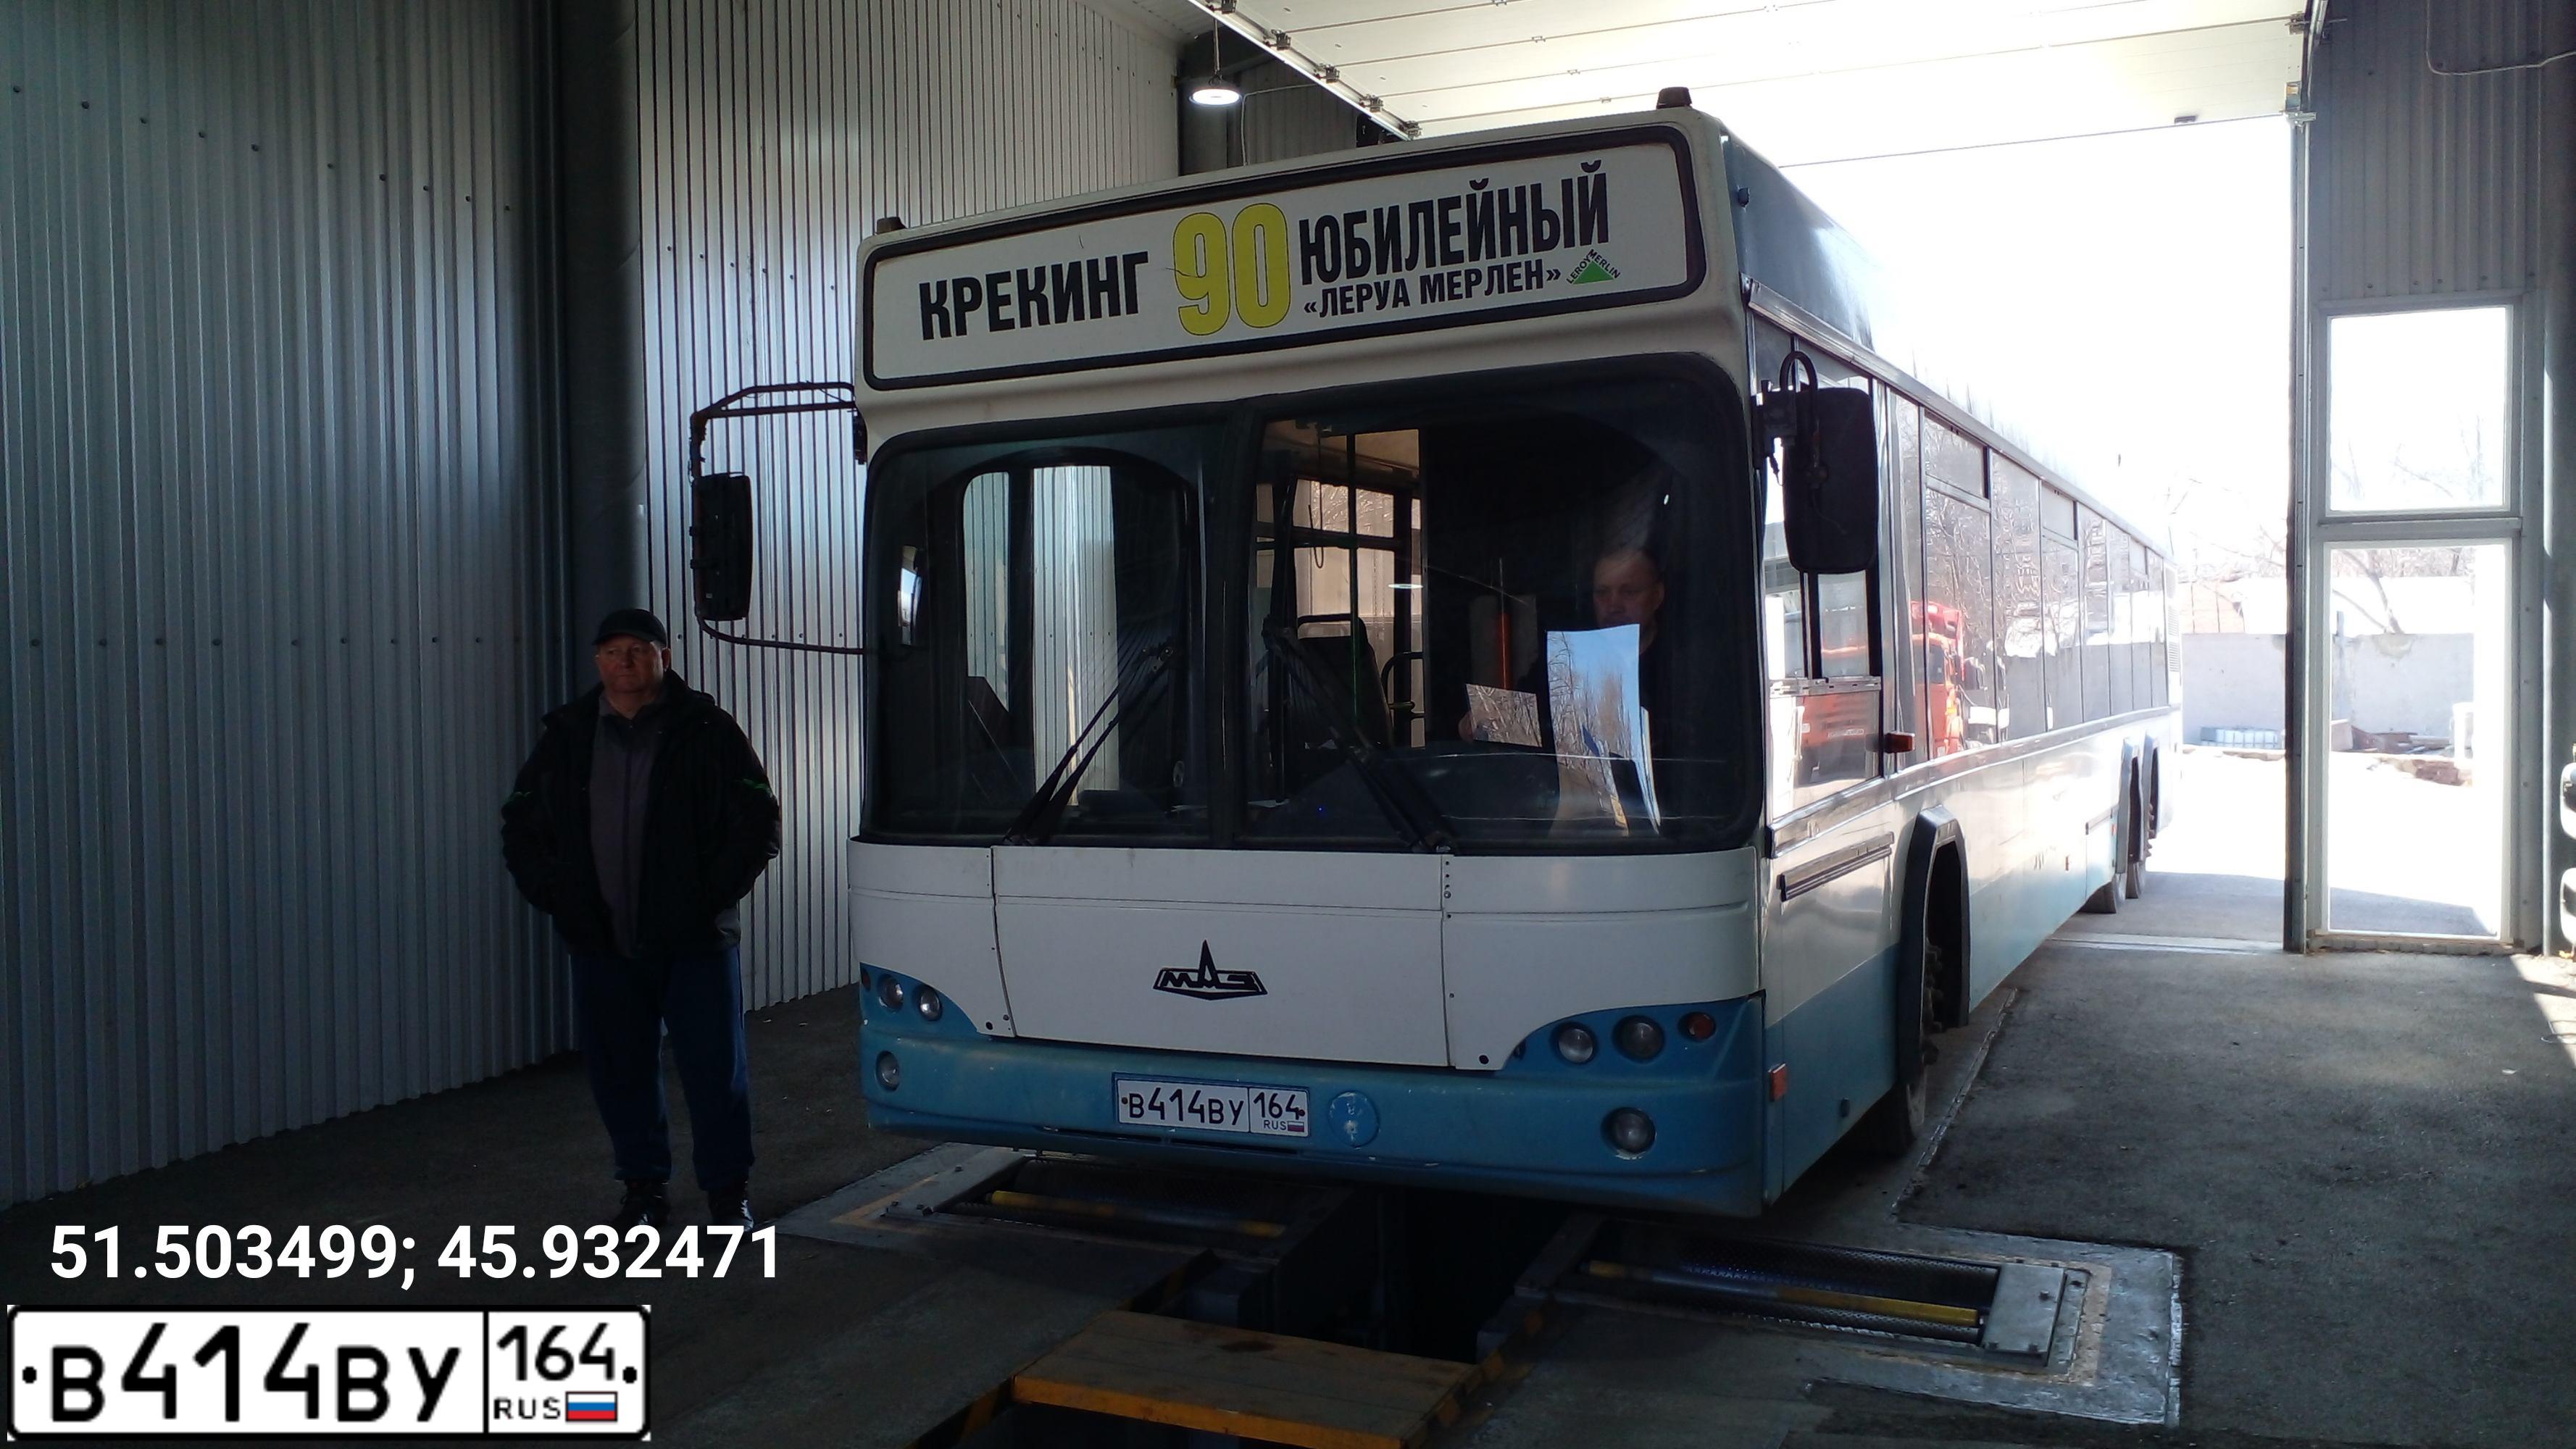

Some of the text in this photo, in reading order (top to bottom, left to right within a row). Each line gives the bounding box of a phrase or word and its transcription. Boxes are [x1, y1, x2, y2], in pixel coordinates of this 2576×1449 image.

[918, 162, 1609, 341] КРЕКИНГ 90 ЮБИЛЕЙНЫЙ
[1566, 249, 1621, 284] LEROY MERLIN
[1304, 258, 1562, 318] «ЛЕРУА МЕРЛЕН»
[1129, 1087, 1301, 1126] В414ВУ 164
[1263, 1119, 1287, 1131] RUS
